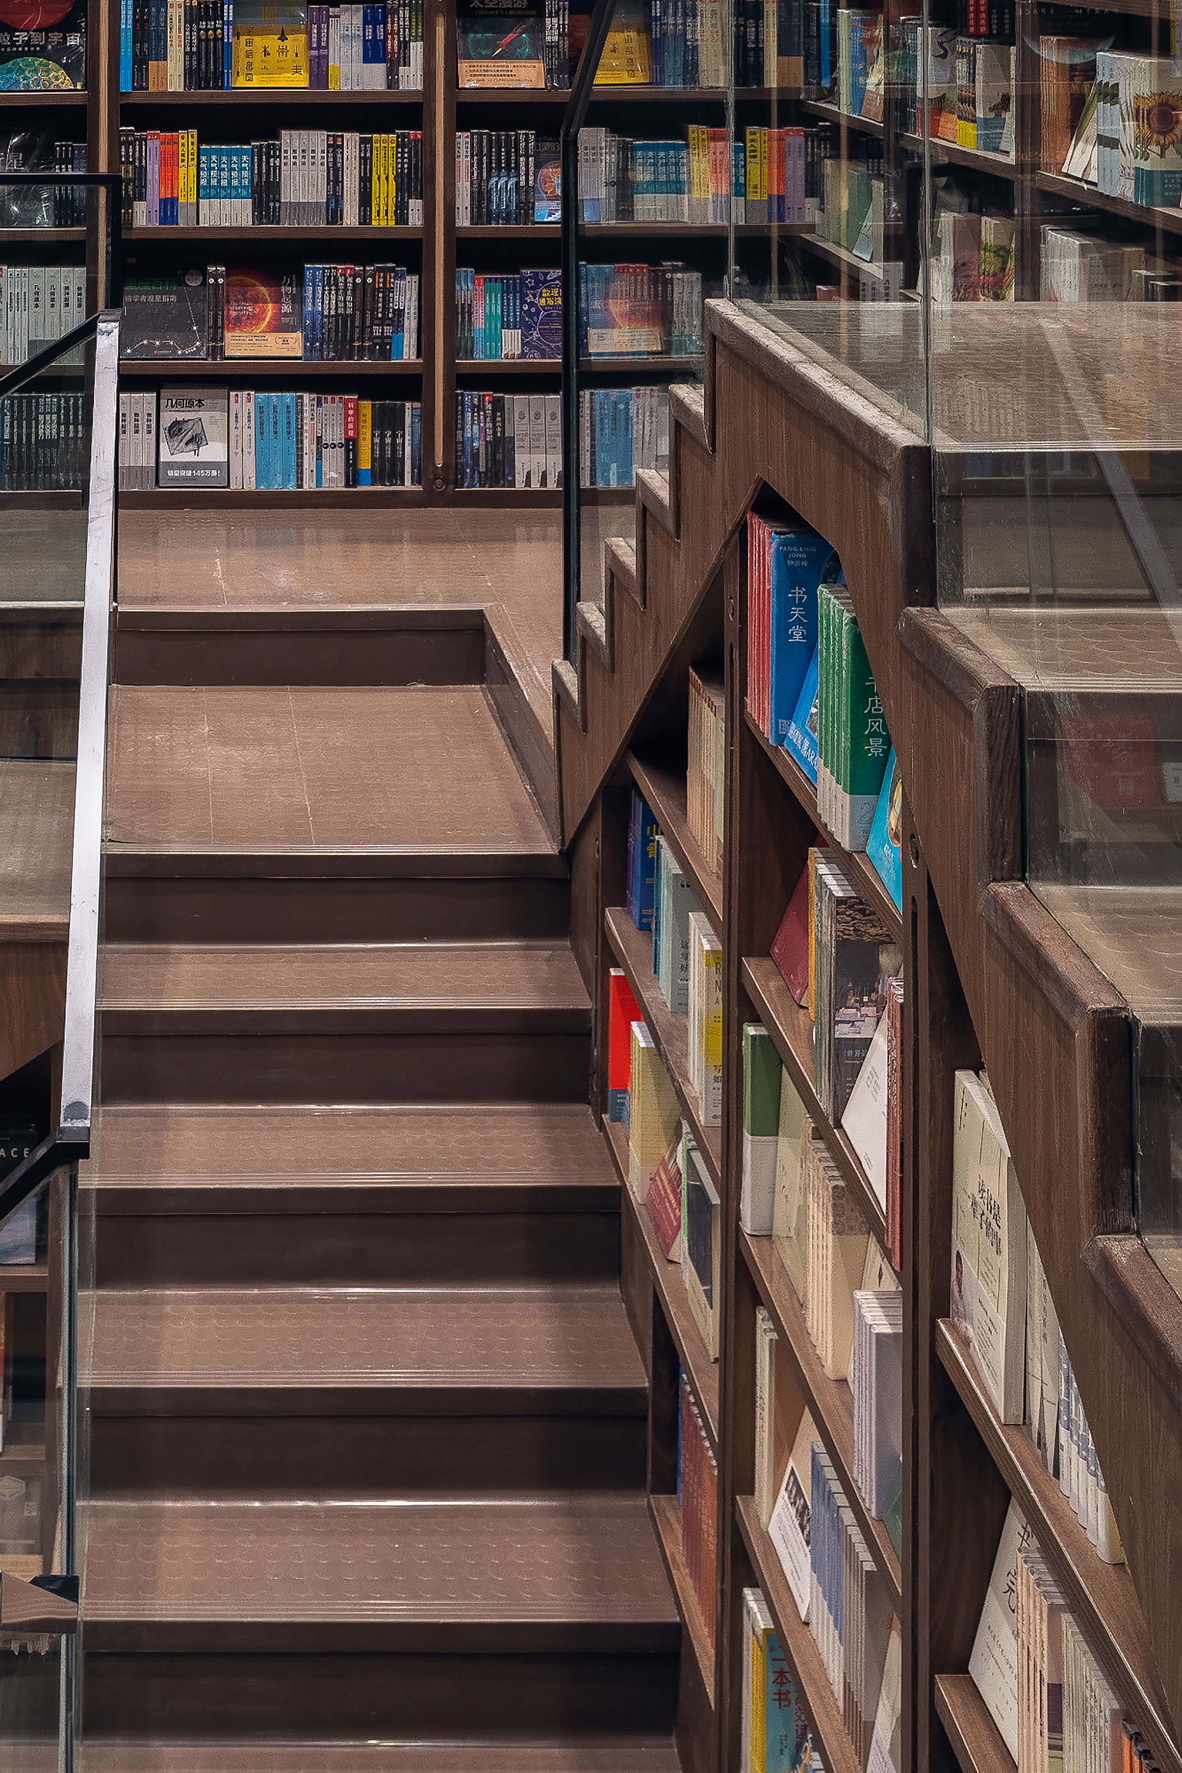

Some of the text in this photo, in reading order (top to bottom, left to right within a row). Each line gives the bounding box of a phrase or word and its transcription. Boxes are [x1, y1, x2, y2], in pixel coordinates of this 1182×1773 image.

[200, 155, 208, 186] 天气预报
[210, 154, 218, 186] 天气预报
[241, 155, 249, 186] 天气预报
[165, 398, 206, 409] 几何原本
[787, 585, 808, 644] 书天堂
[771, 1656, 792, 1710] 一本书
